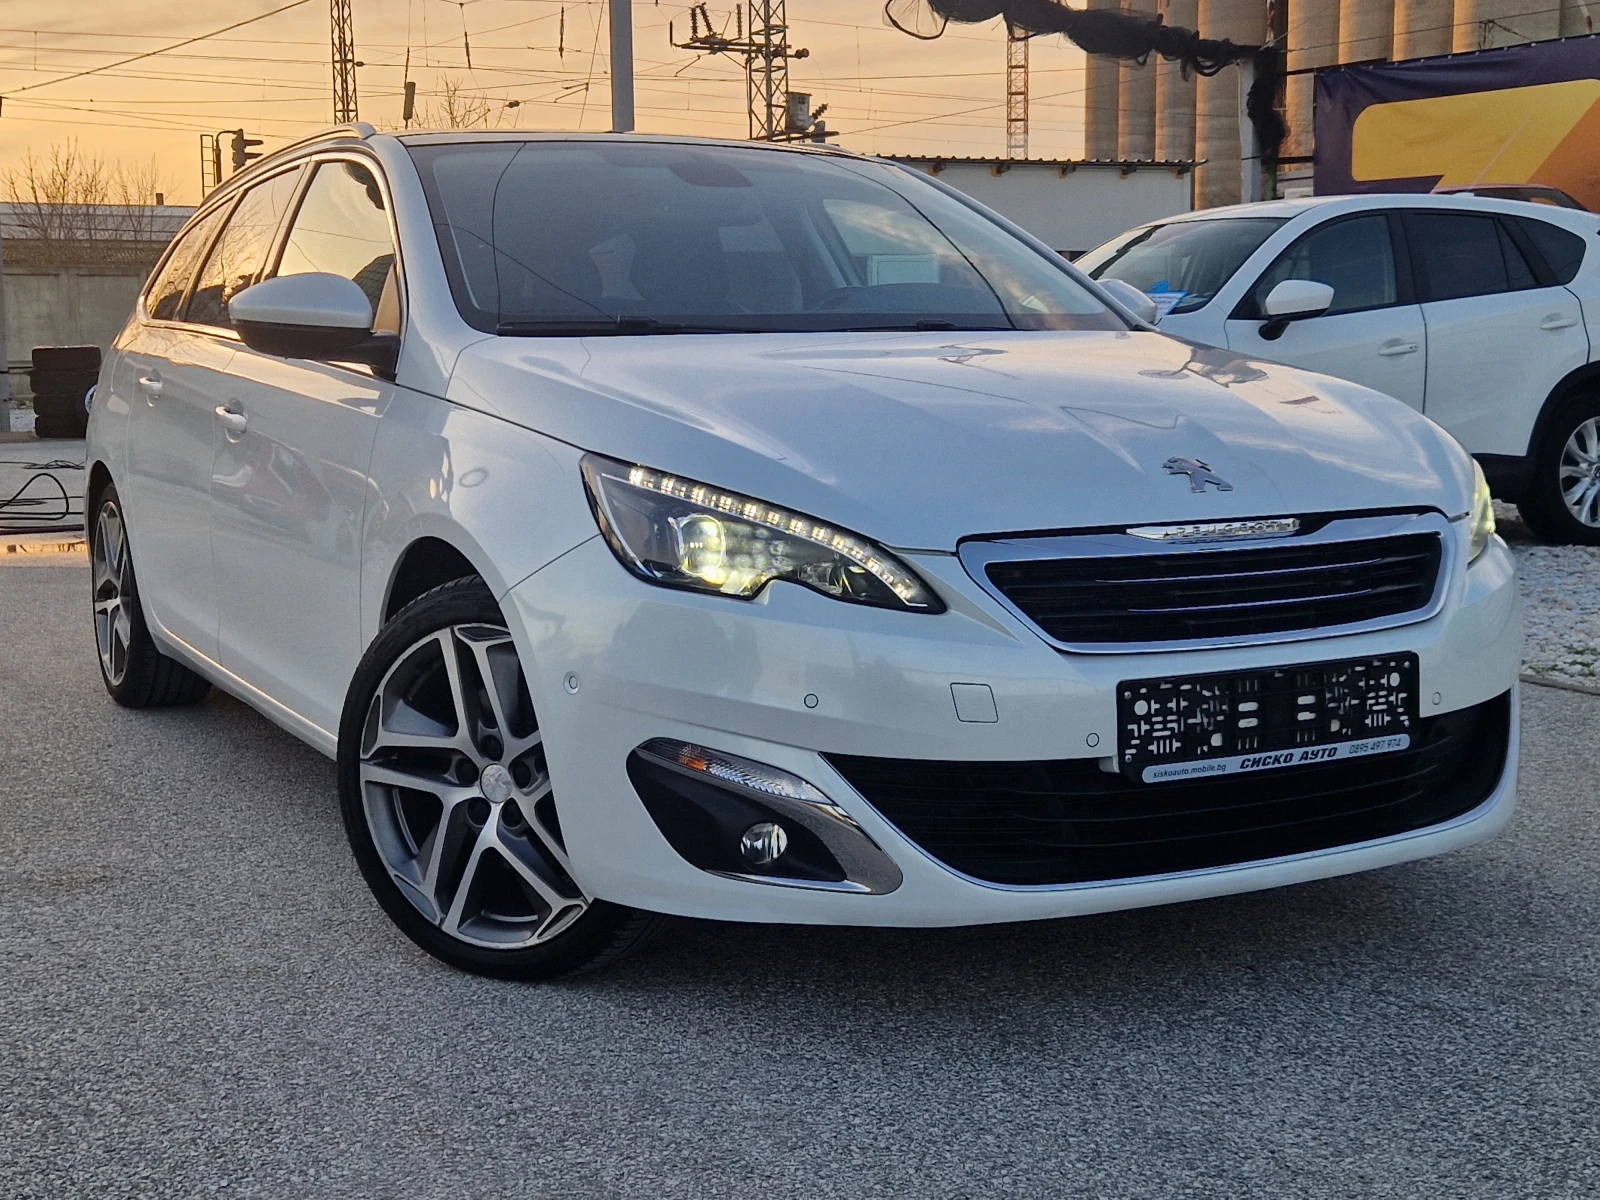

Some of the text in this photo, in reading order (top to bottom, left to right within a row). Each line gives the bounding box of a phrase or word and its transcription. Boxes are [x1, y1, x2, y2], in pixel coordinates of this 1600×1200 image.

[1176, 520, 1282, 537] PEUGEOT
[1349, 738, 1401, 754] 0895 497 974
[1239, 747, 1338, 769] СИСКО АУТО
[1153, 764, 1226, 778] siskoauto.mobile.bg
